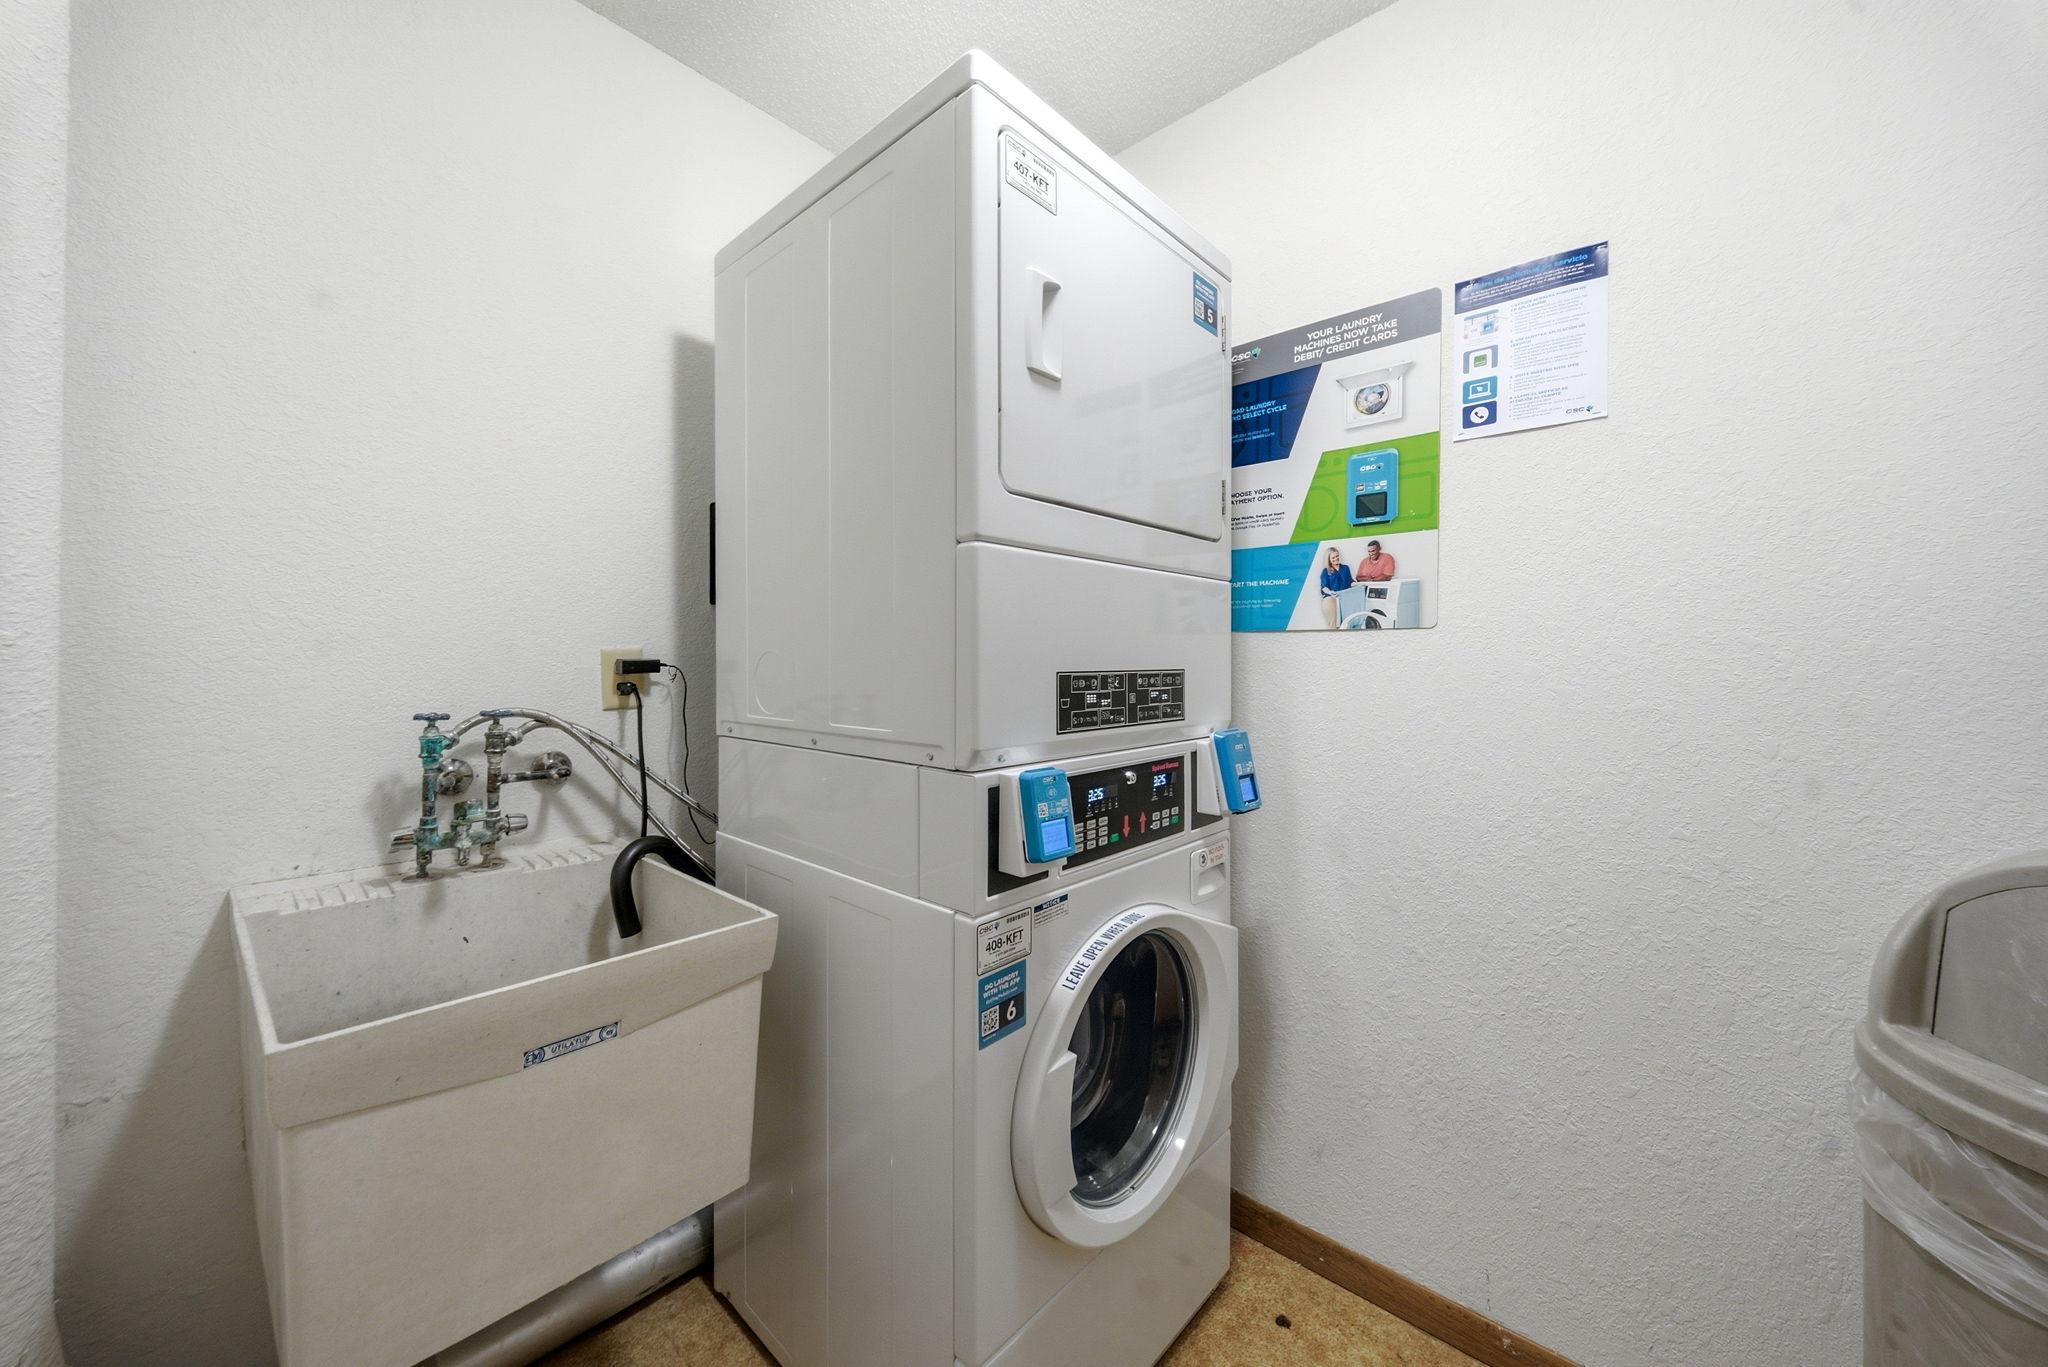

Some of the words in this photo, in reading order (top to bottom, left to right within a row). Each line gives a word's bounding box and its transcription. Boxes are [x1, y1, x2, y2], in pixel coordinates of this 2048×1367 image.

[1013, 161, 1049, 192] 407-KFT
[1554, 253, 1588, 268] servicio
[1207, 308, 1213, 324] 5
[1294, 335, 1342, 354] MACHINES
[1344, 327, 1370, 340] NOW
[1371, 319, 1398, 333] TAKE
[1307, 327, 1334, 341] YOUR
[1335, 313, 1382, 334] LAUNDRY
[1294, 346, 1324, 363] DEBIT/
[1326, 339, 1361, 355] CREDIT
[1363, 328, 1398, 344] CARDS
[1231, 351, 1251, 362] CSC
[1231, 407, 1245, 415] OAD
[1246, 399, 1277, 412] LAUNDRY
[1242, 409, 1266, 420] SELECT
[1266, 404, 1287, 414] CYCLE
[1231, 490, 1253, 499] HOOSE
[1231, 496, 1256, 505] AYMENT
[1259, 578, 1290, 586] MACHINE
[985, 929, 1024, 952] 408-KFT
[1062, 960, 1090, 991] LEAVE
[1082, 939, 1108, 961] OPEN
[1101, 922, 1128, 940] WHEN
[983, 988, 998, 999] WITH
[999, 982, 1009, 992] THE
[1009, 976, 1020, 987] APP
[984, 982, 993, 991] DO
[994, 970, 1019, 987] LAUNDRY
[1006, 1000, 1017, 1021] 6
